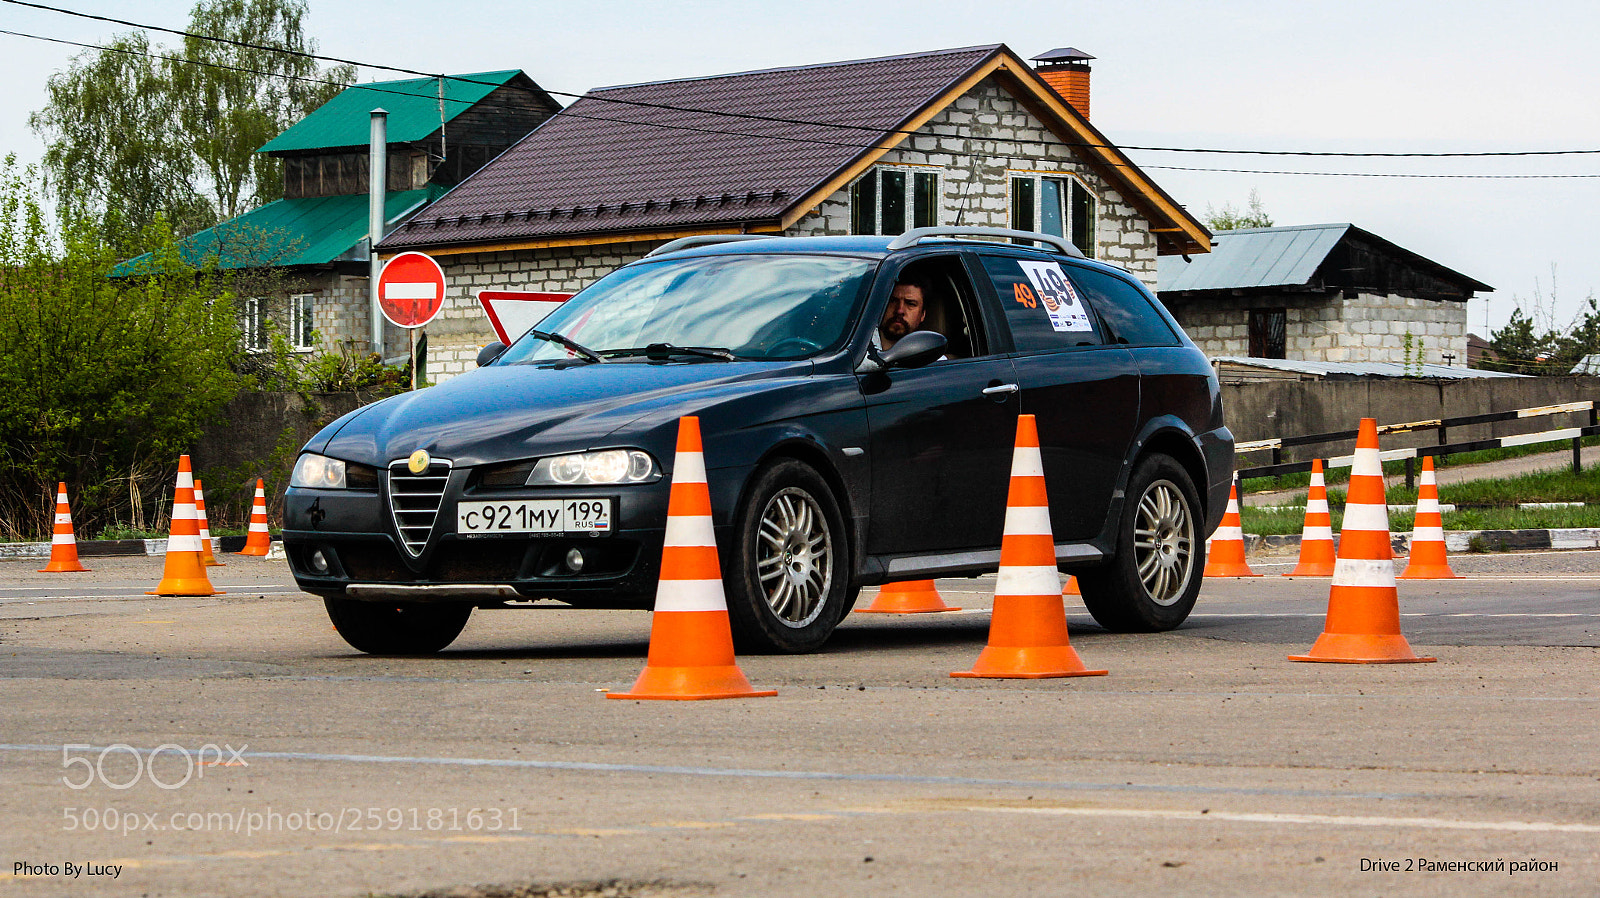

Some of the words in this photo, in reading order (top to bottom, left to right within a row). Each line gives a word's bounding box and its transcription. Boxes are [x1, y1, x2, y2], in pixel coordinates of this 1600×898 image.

[1013, 283, 1037, 309] 49
[1032, 268, 1073, 307] 49
[567, 501, 603, 520] 199
